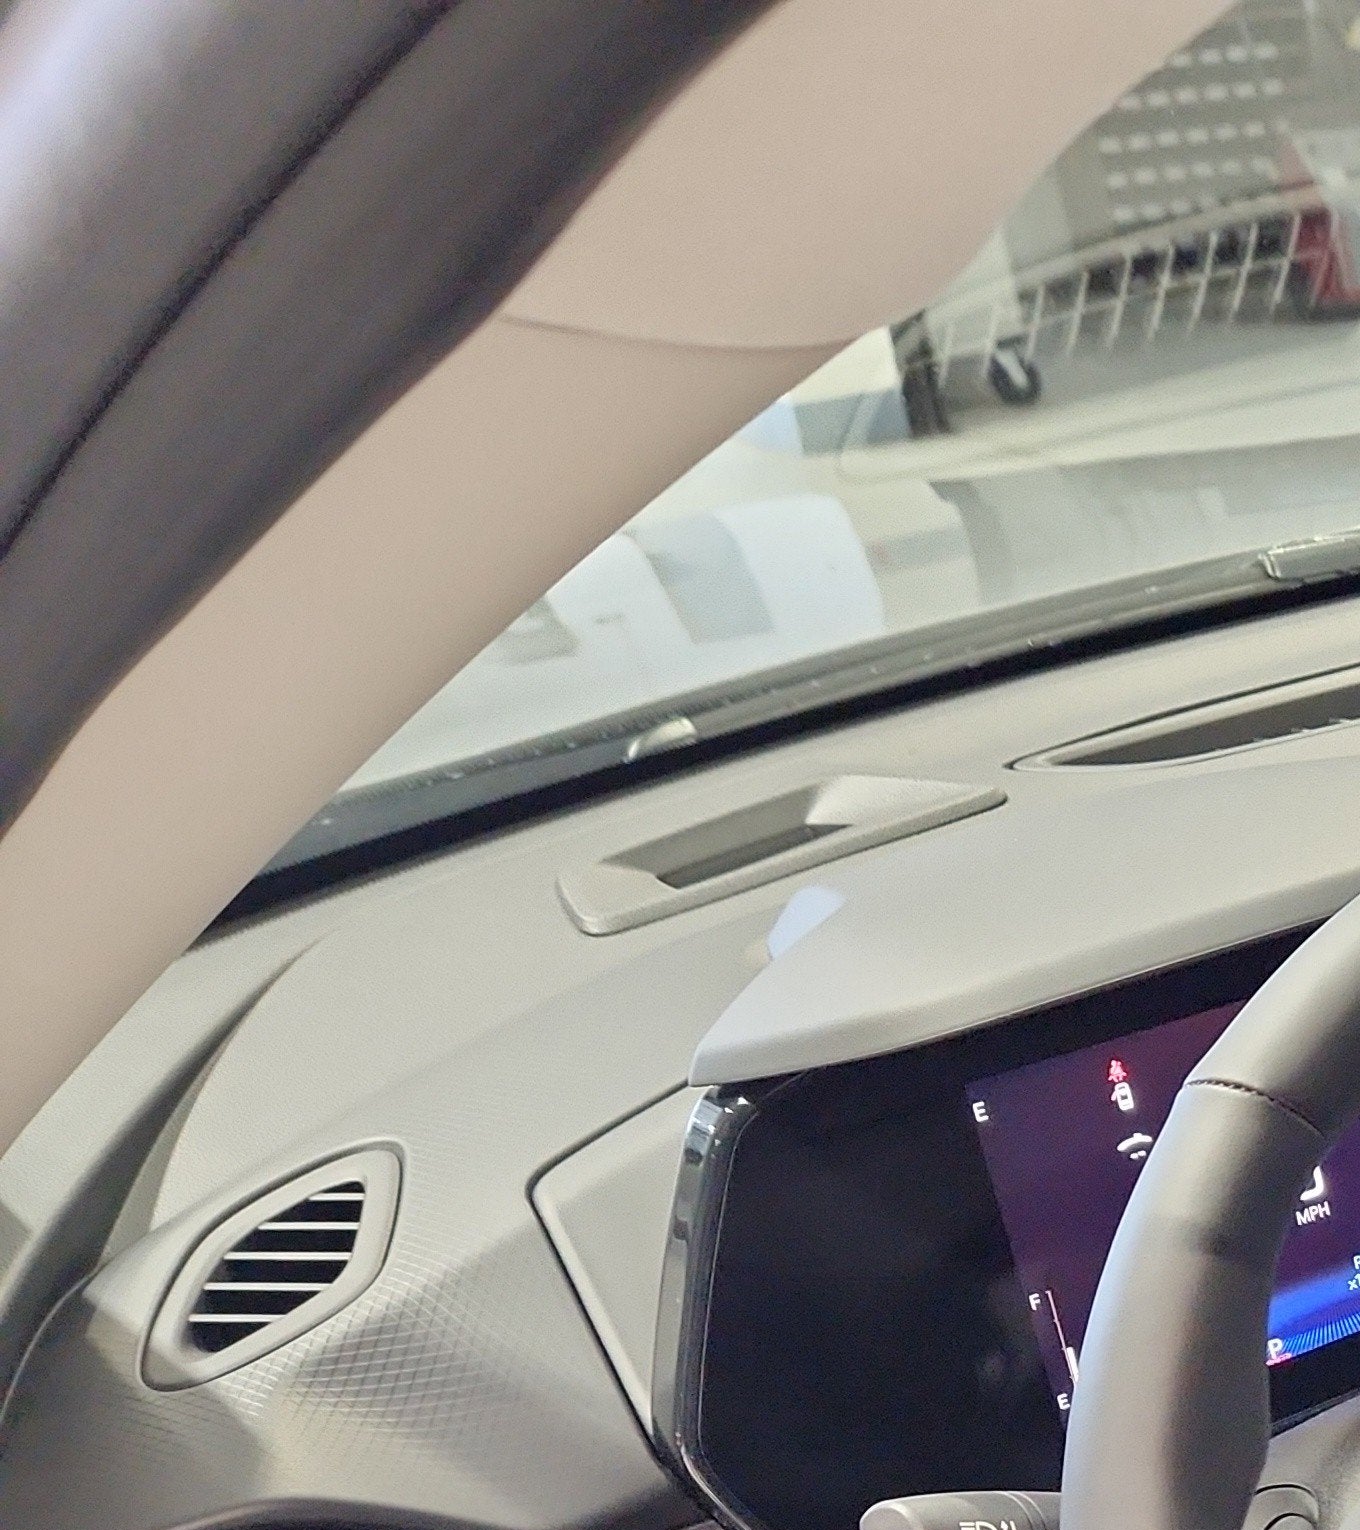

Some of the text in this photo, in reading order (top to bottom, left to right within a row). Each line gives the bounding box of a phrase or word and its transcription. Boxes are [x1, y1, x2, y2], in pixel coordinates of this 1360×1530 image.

[972, 1101, 989, 1122] E
[1295, 1200, 1332, 1226] MPH
[1028, 1293, 1041, 1311] F
[1267, 1338, 1283, 1361] P
[1056, 1393, 1070, 1410] E
